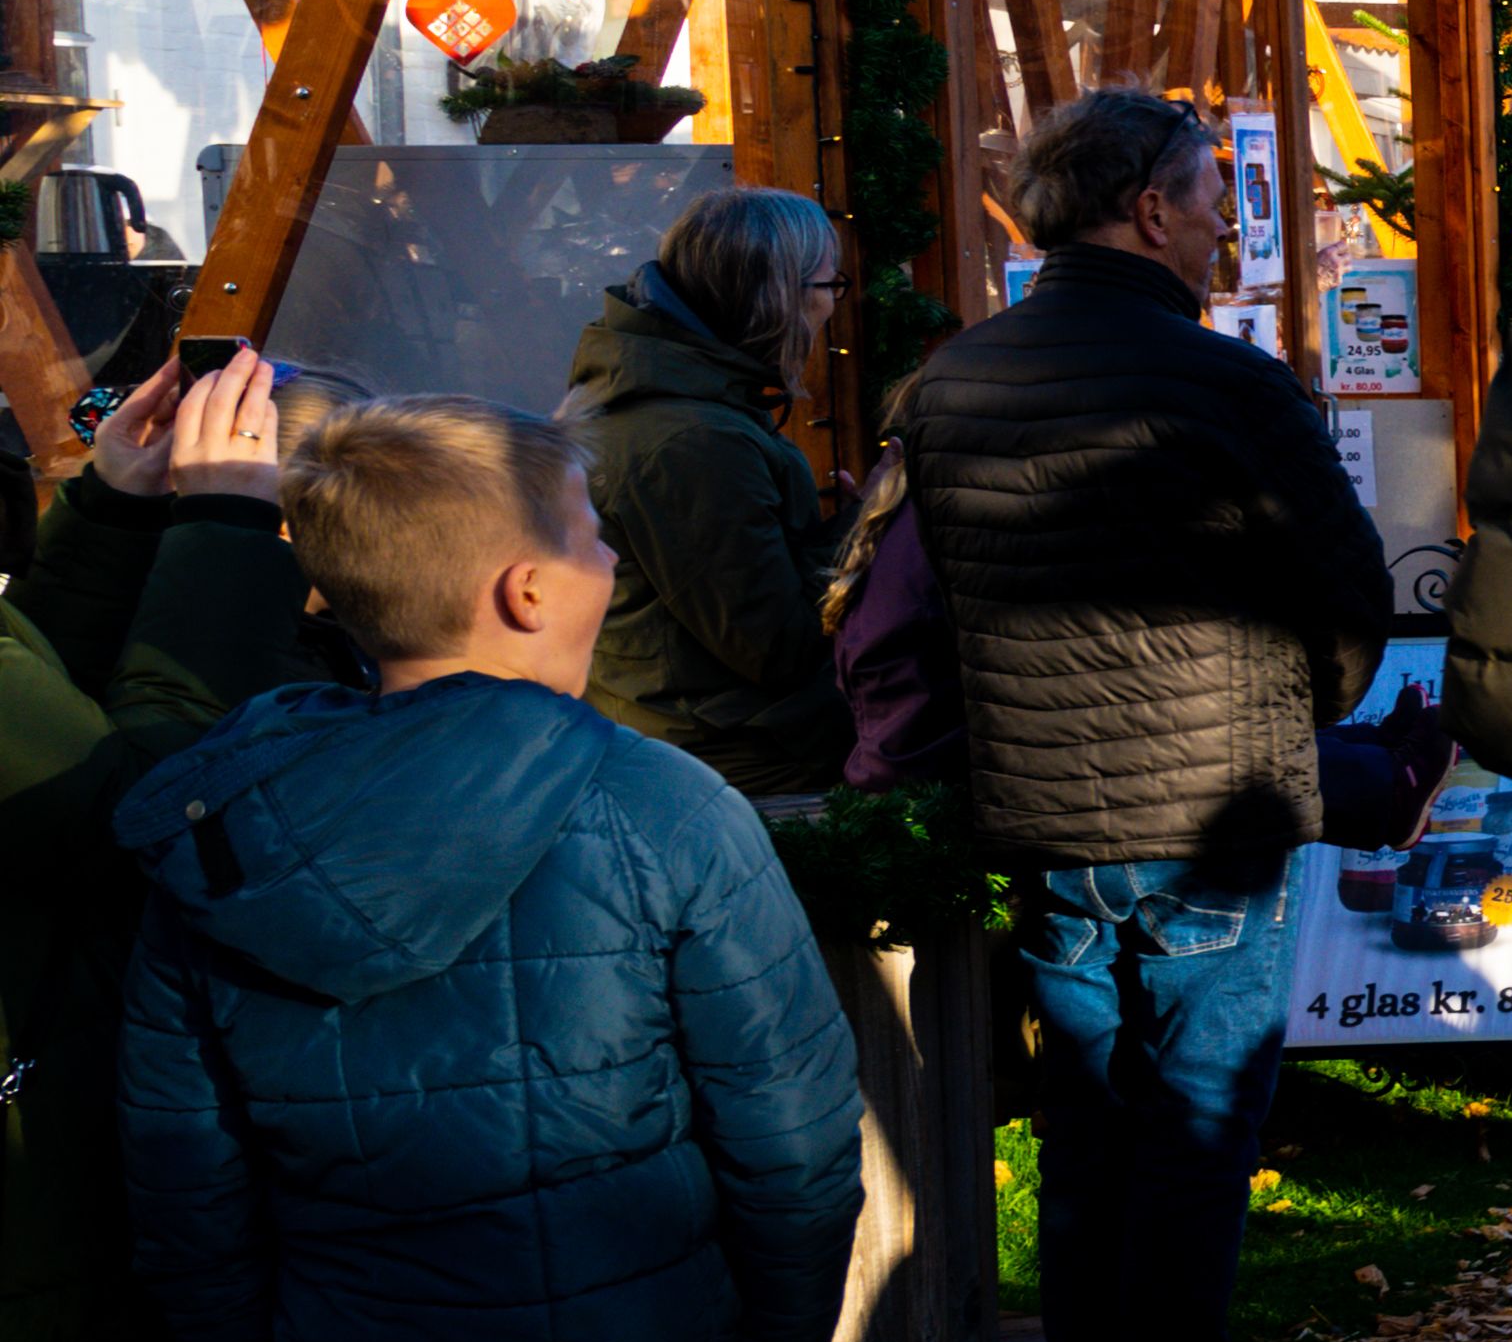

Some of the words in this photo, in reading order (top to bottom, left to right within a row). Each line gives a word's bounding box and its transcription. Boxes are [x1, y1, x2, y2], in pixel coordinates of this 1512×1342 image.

[1347, 345, 1382, 357] 24,95
[1345, 366, 1352, 374] 4
[1354, 366, 1375, 375] Glas
[1340, 382, 1354, 391] kr.
[1356, 382, 1383, 392] 80,00
[1306, 992, 1330, 1020] 4
[1338, 982, 1421, 1027] glas
[1429, 980, 1485, 1015] kr.
